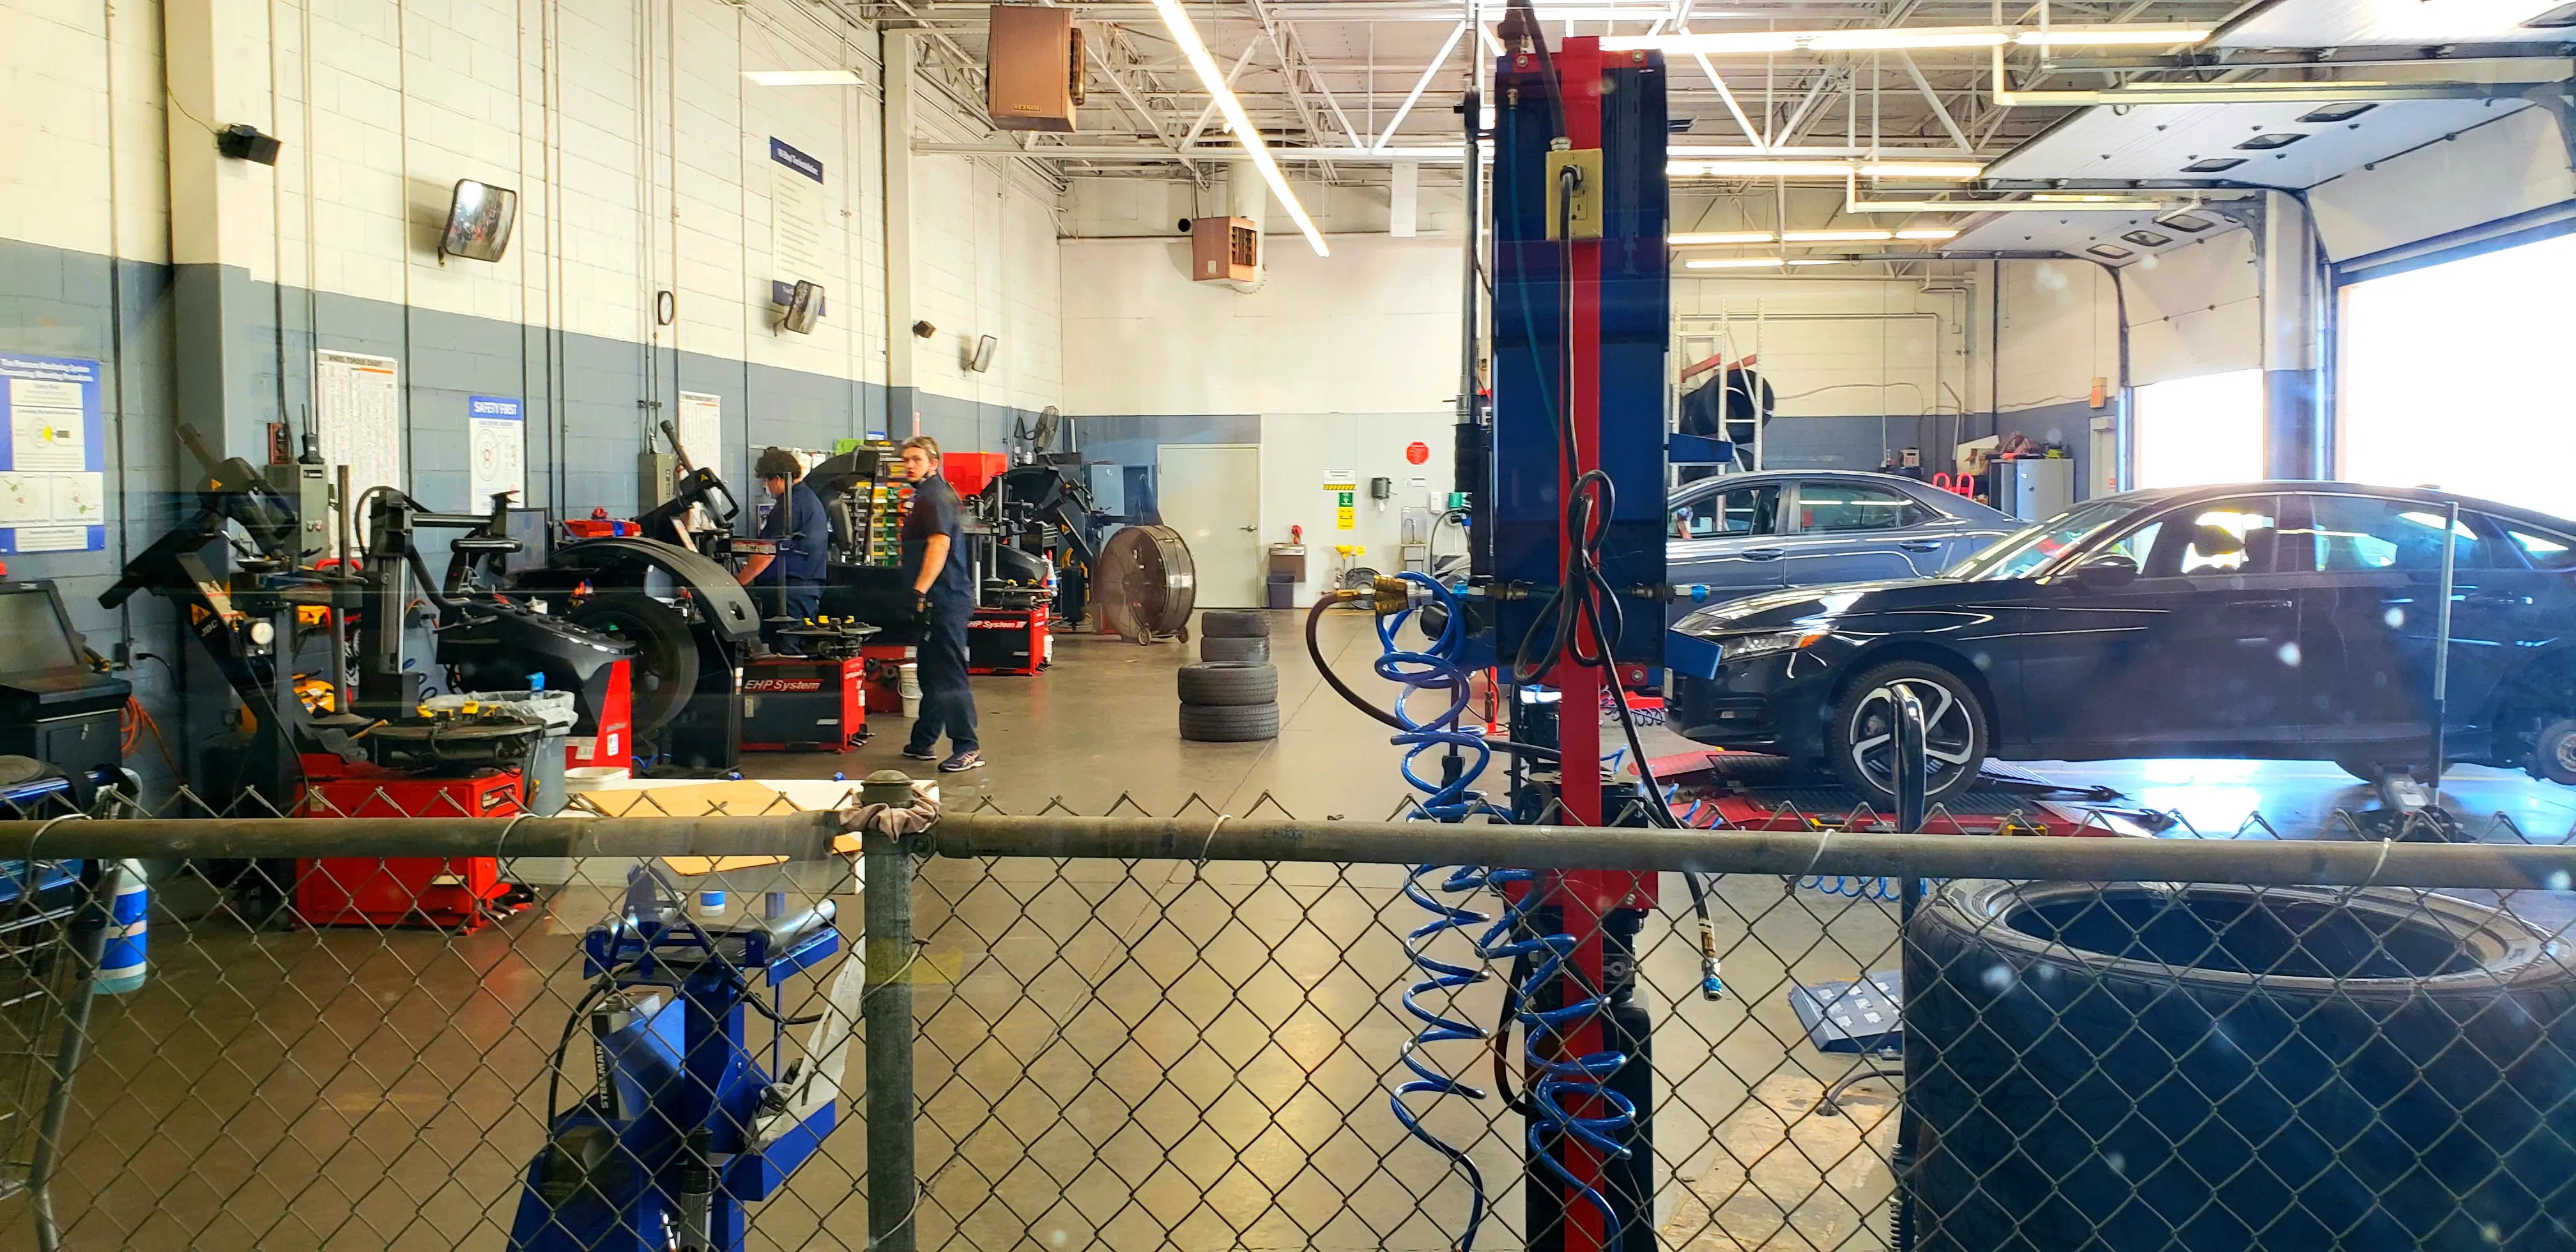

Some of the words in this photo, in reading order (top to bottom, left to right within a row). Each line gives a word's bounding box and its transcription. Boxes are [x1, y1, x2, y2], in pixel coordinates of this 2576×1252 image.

[473, 401, 499, 414] SAFETY
[500, 403, 518, 415] FIRST
[983, 620, 1015, 629] System
[744, 680, 773, 689] EHP
[773, 680, 820, 691] System
[595, 1045, 610, 1109] STEELMAN
